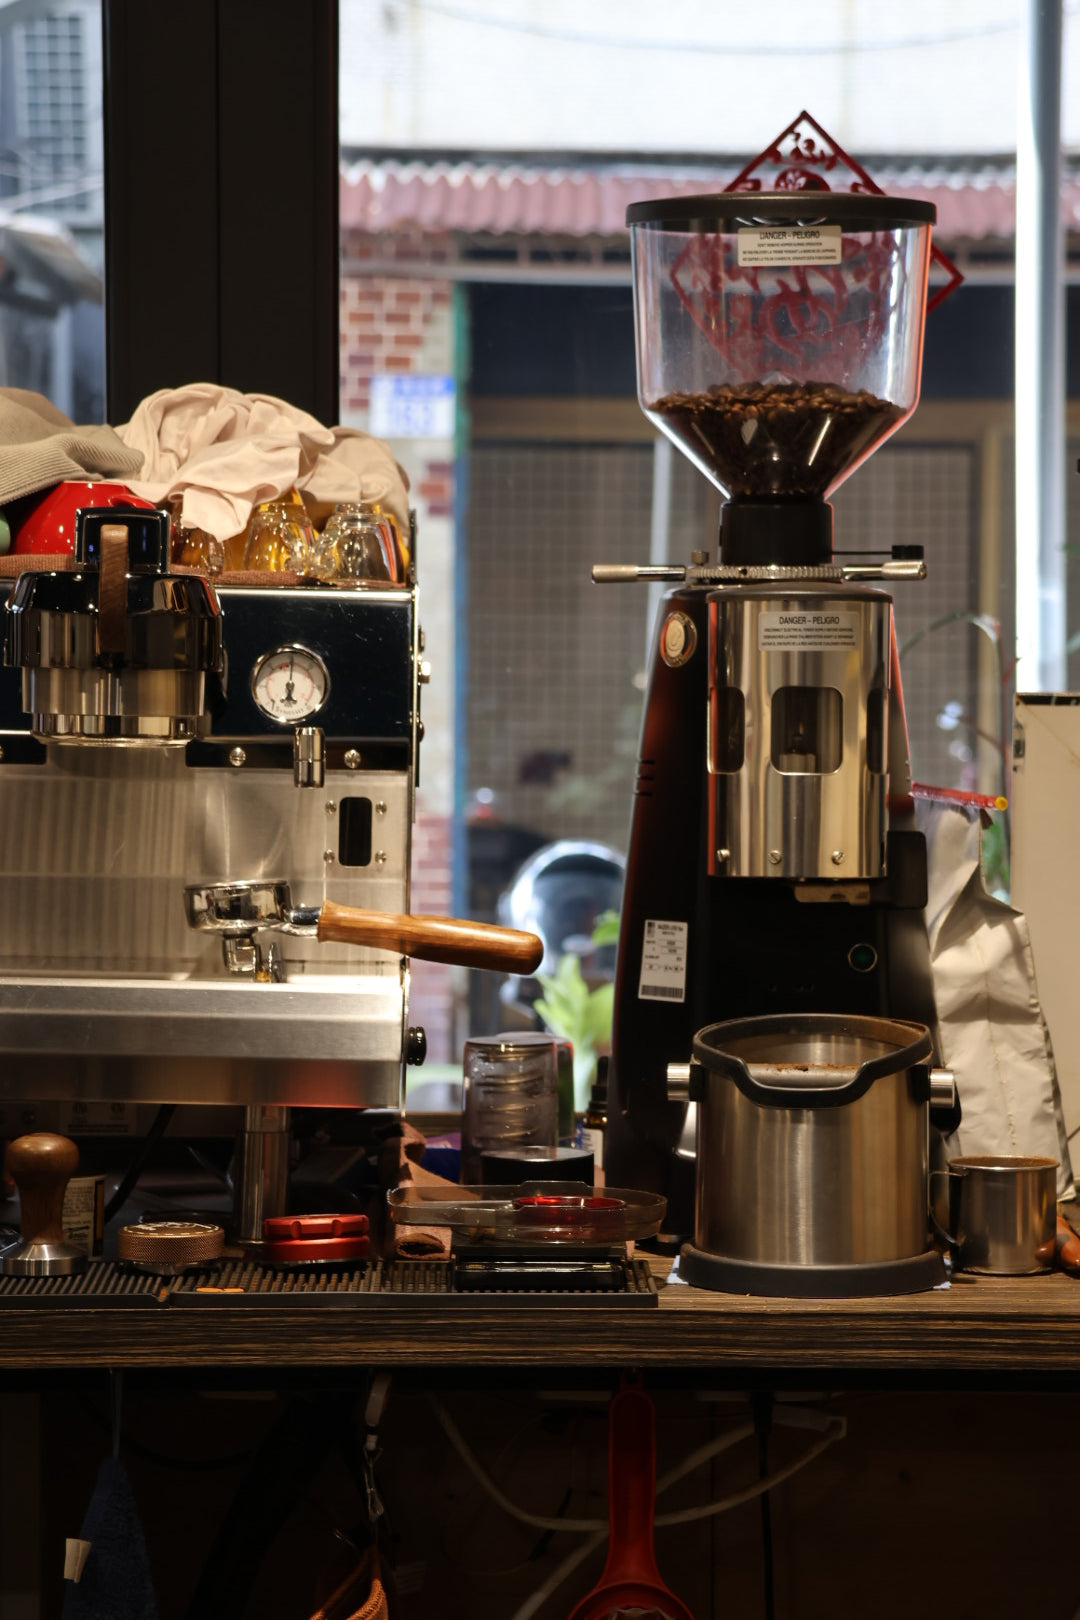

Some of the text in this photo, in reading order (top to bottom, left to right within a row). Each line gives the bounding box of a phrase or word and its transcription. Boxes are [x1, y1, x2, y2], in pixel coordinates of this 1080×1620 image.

[792, 230, 820, 239] PELIGRO
[779, 616, 806, 624] DANGER
[812, 616, 839, 624] PELIGRO
